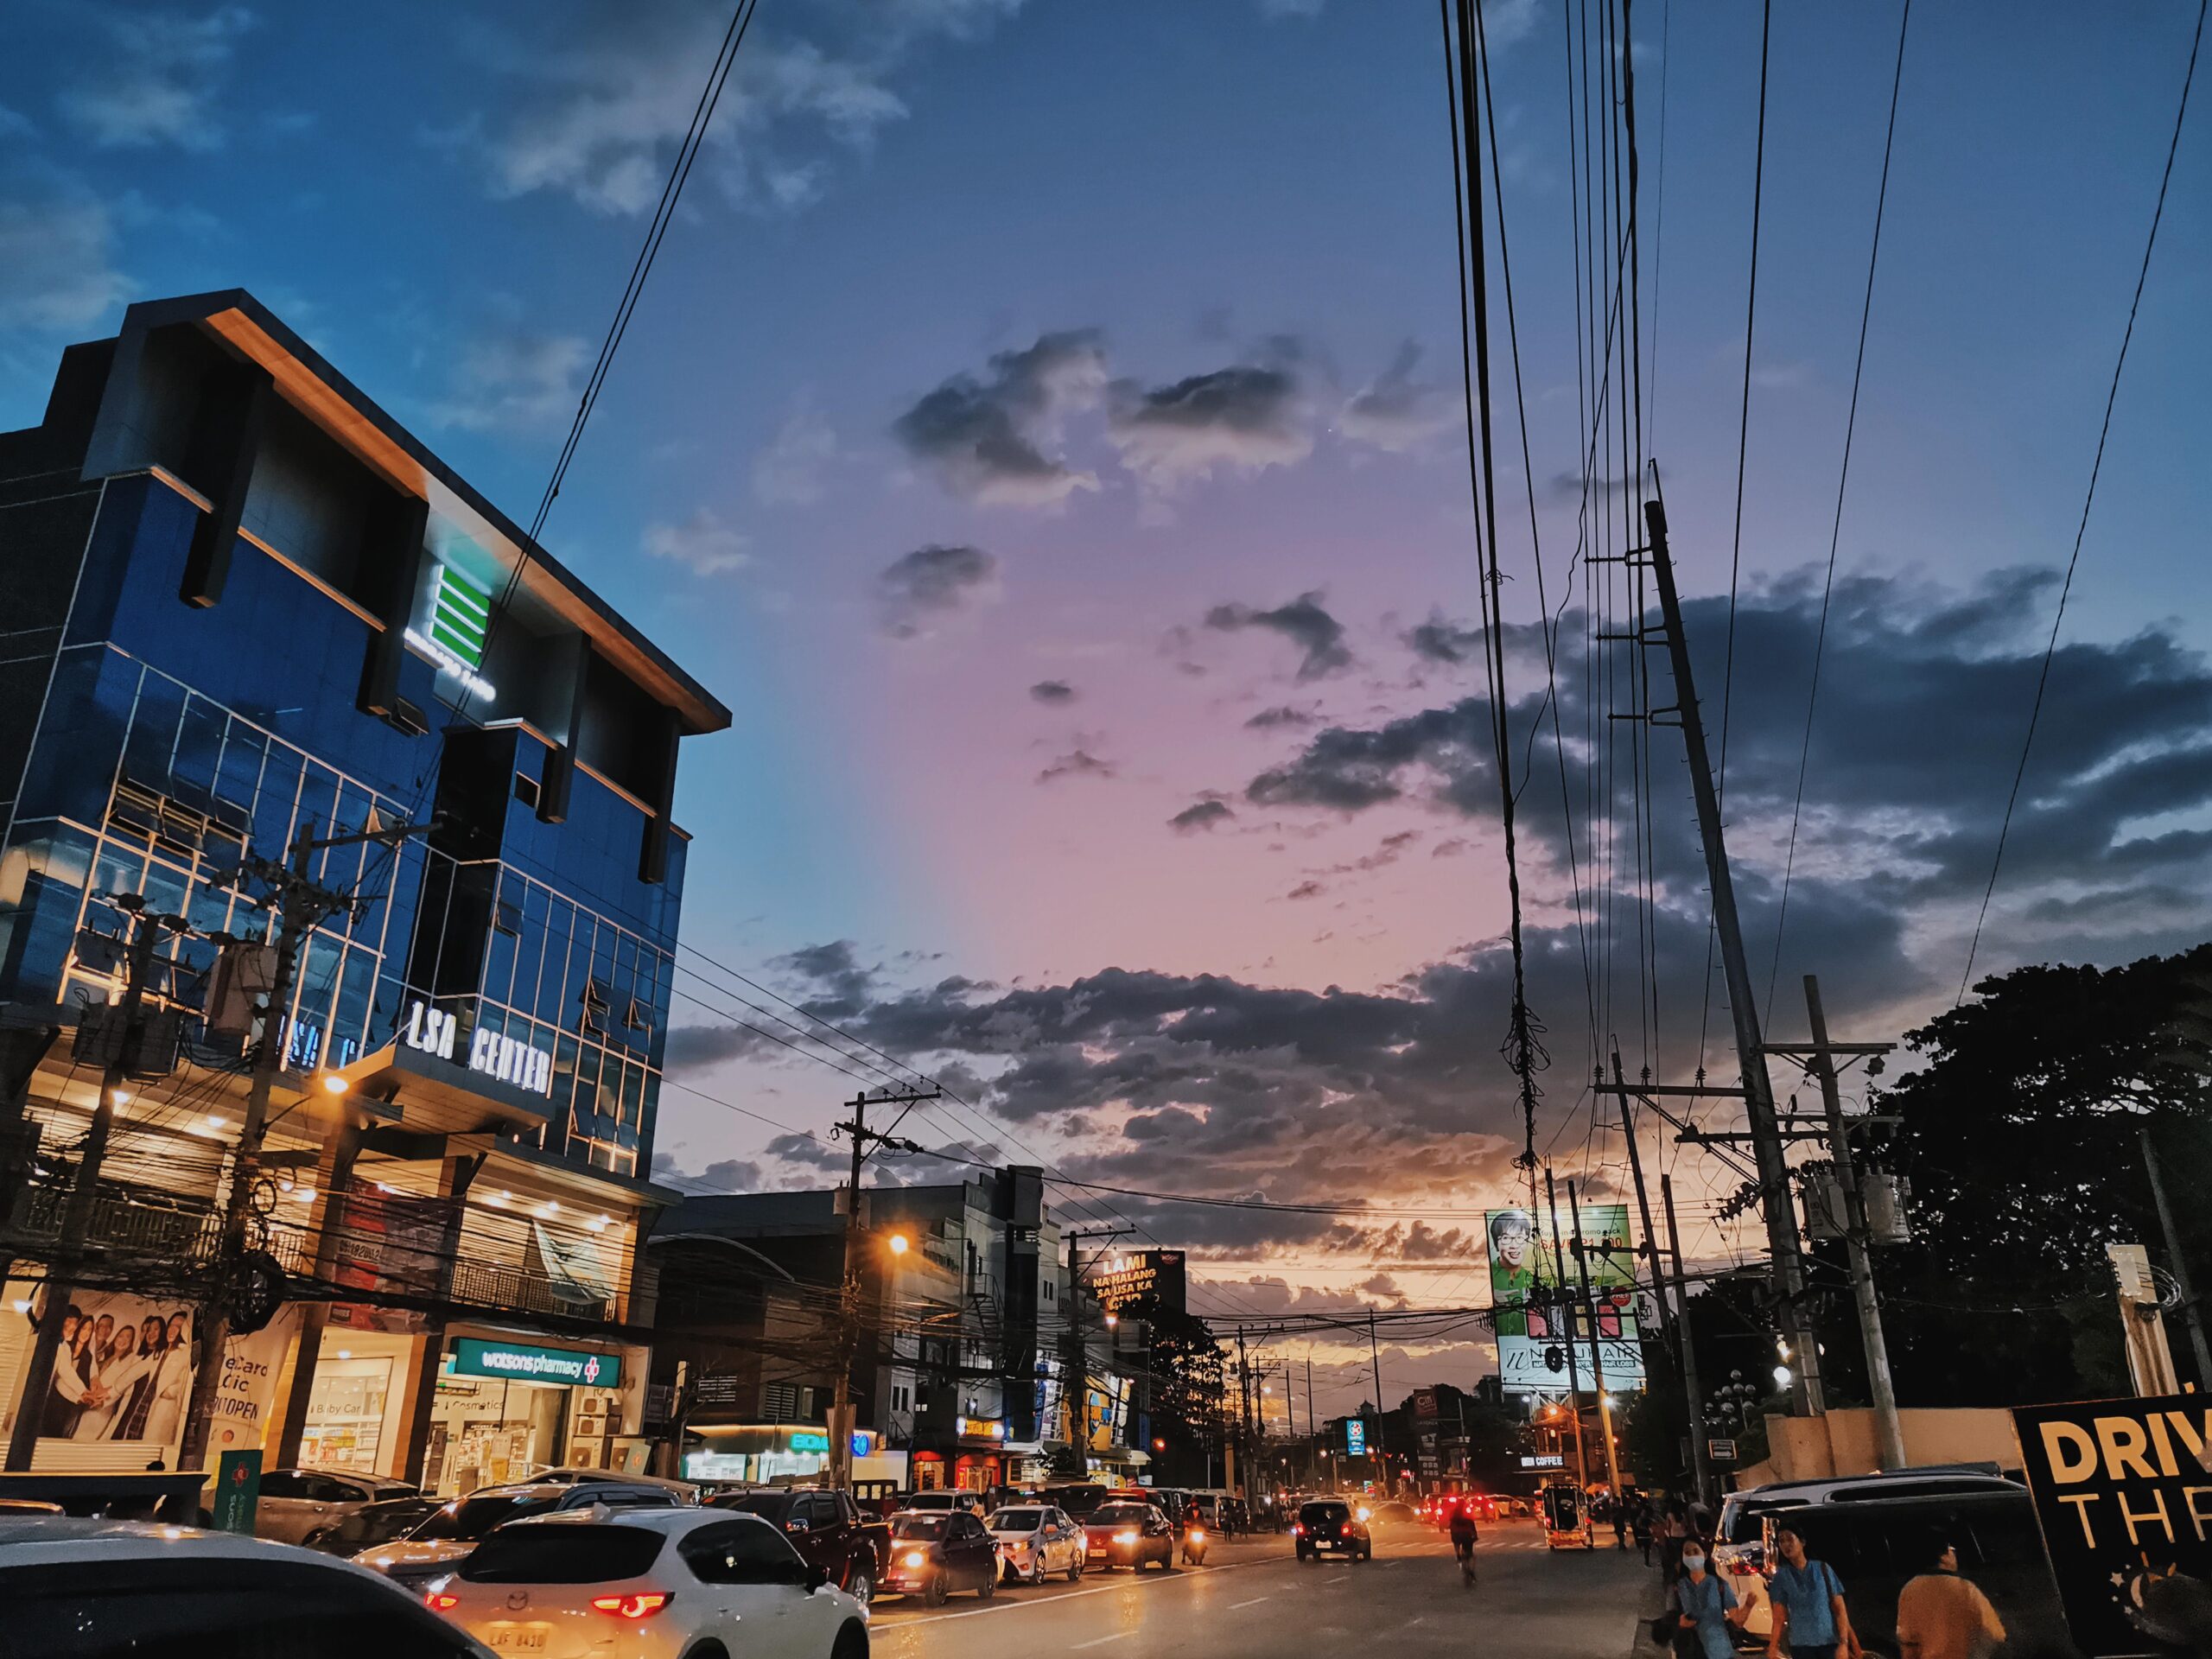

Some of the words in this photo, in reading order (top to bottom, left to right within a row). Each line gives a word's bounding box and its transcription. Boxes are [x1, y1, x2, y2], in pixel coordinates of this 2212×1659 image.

[406, 1001, 456, 1059] LSA
[471, 1027, 550, 1094] CENTER
[1103, 1254, 1146, 1274] LAMI
[1093, 1277, 1110, 1287] NA
[1112, 1268, 1156, 1285] HALANG
[1096, 1287, 1111, 1299] SA
[1114, 1283, 1135, 1295] USA
[1137, 1280, 1153, 1291] KA
[481, 1351, 534, 1372] watsons
[533, 1354, 583, 1378] pharmacy
[1535, 1456, 1563, 1466] COFFEE
